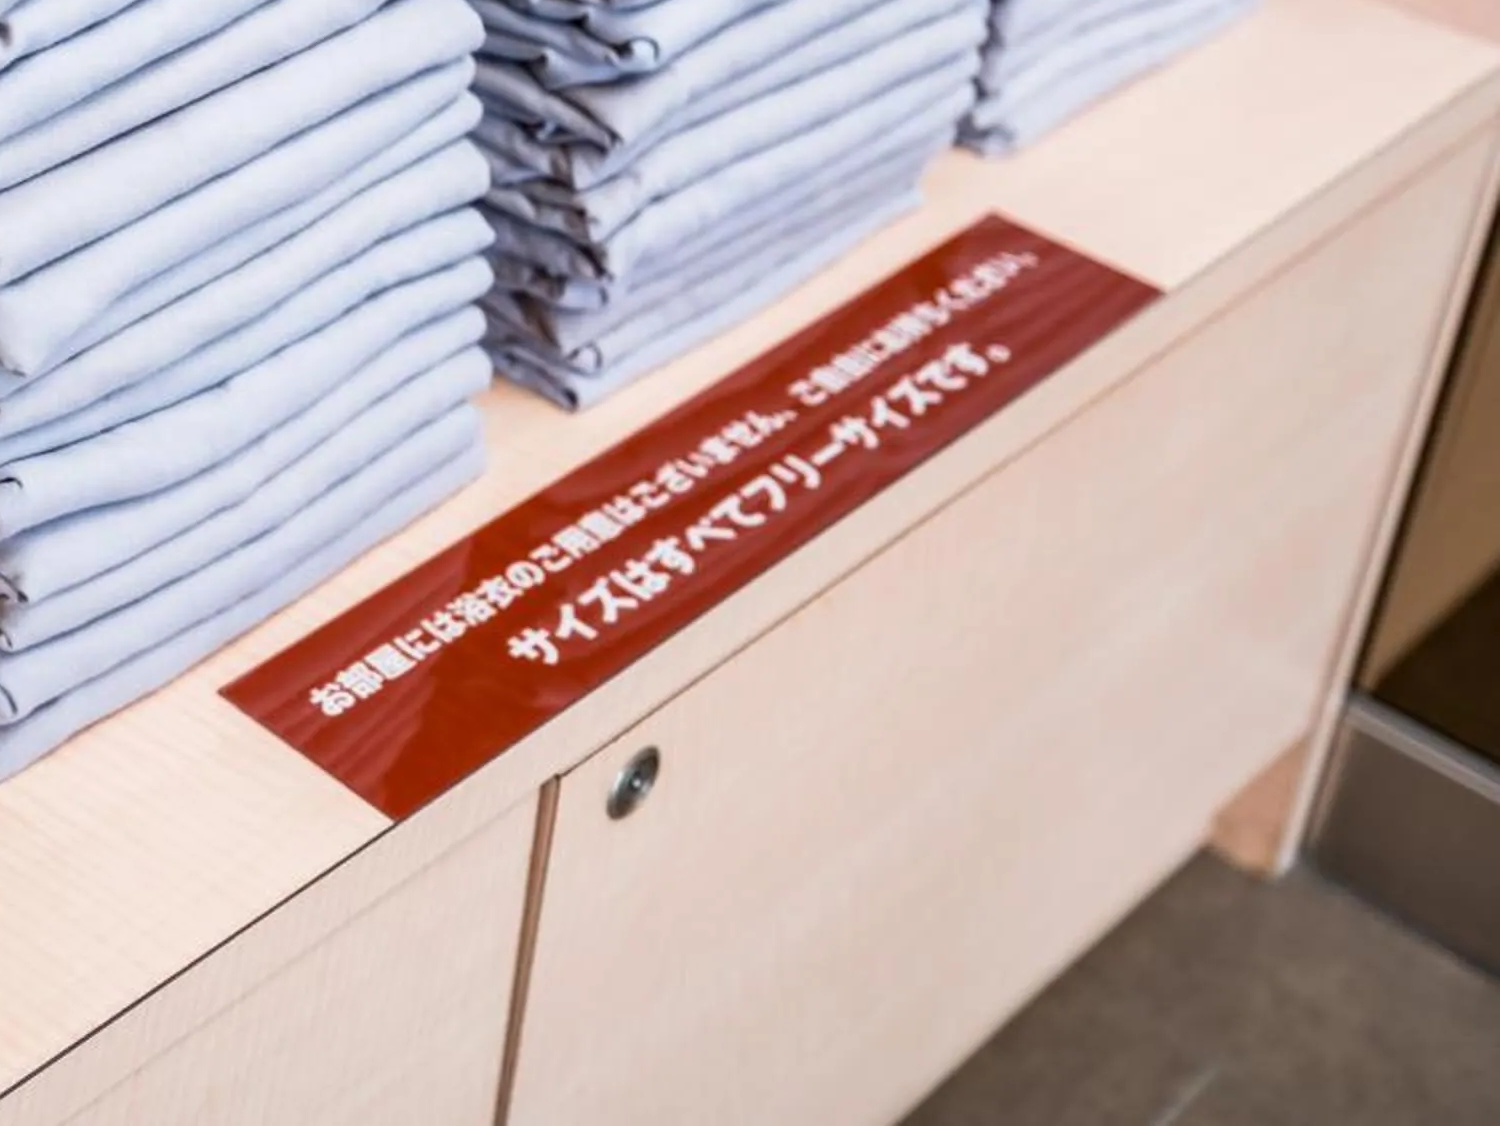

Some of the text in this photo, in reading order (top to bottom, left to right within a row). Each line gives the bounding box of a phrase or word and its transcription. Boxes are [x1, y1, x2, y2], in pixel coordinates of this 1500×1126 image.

[507, 342, 1012, 666] サイズはすべてフリーサイズです。
